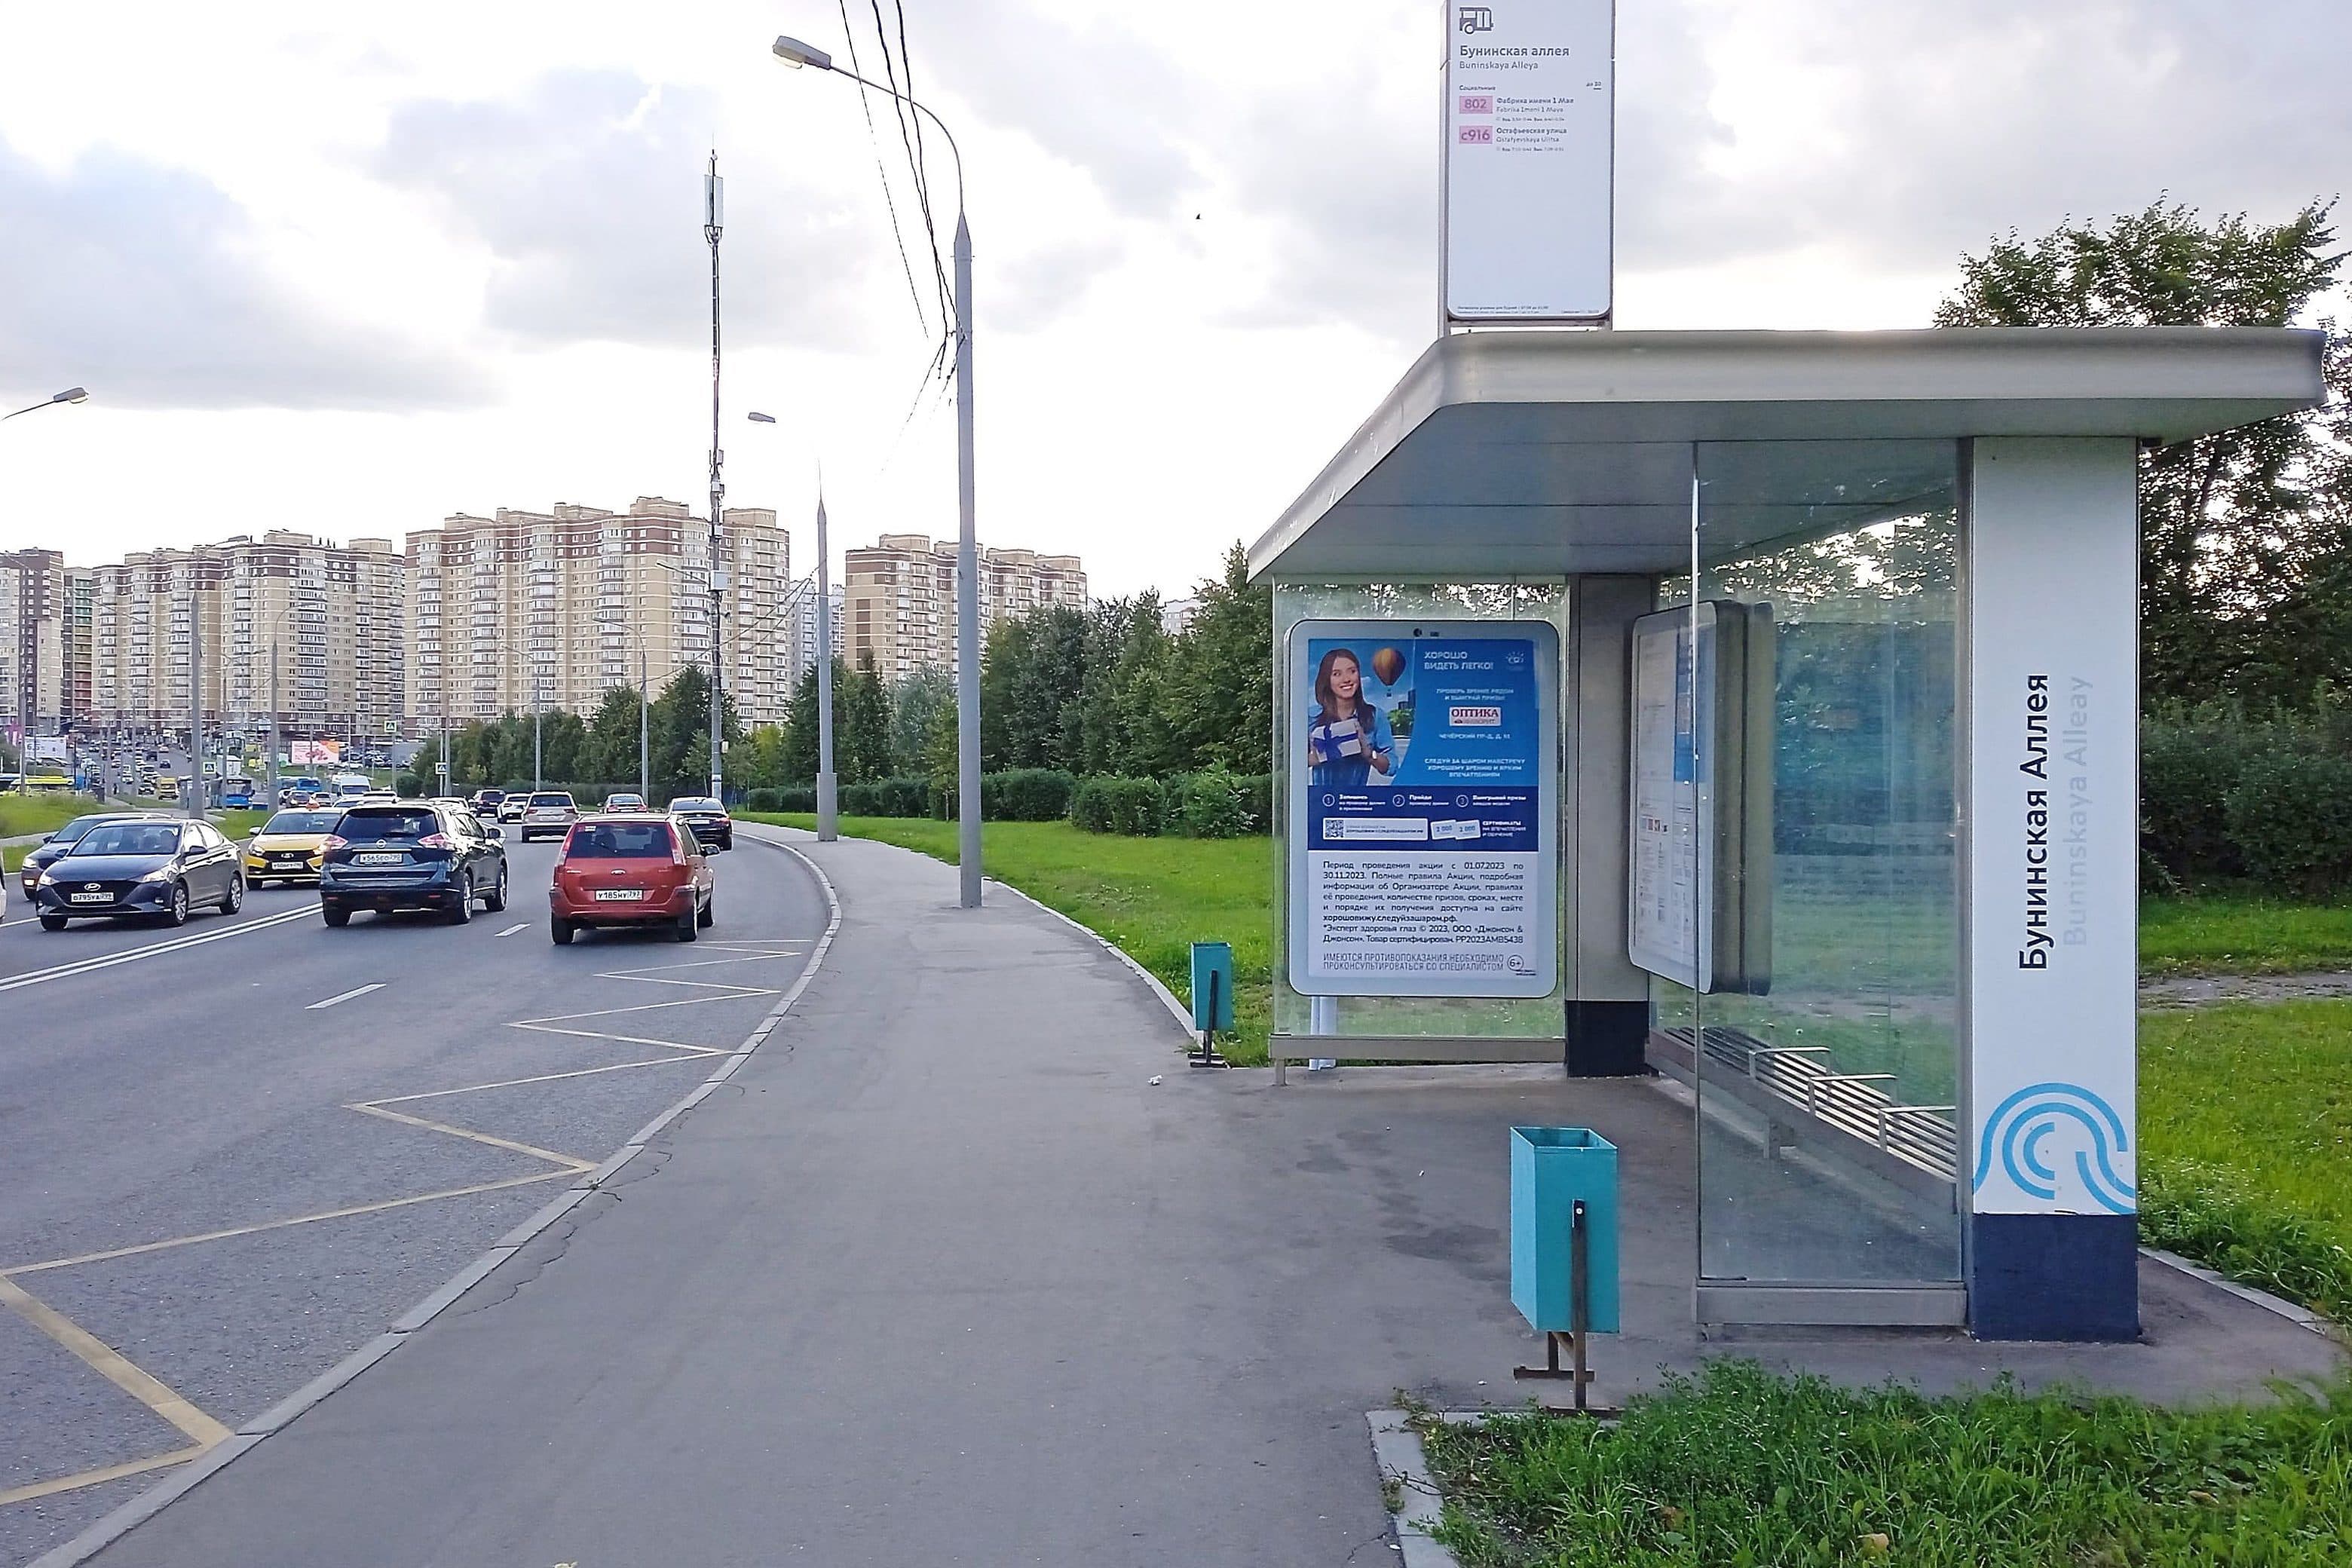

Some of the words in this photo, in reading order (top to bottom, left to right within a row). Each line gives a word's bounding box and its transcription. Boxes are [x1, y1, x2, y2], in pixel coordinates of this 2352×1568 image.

[1459, 45, 1528, 58] Бунинская
[1531, 47, 1570, 57] аллея
[1459, 61, 1509, 70] Buninskaya
[1511, 61, 1539, 70] Alleya
[1465, 99, 1487, 109] 802
[1461, 129, 1490, 141] с916
[1424, 651, 1468, 660] ХОРОШО
[1424, 662, 1459, 671] ВИДЕТЬ
[1461, 662, 1494, 670] ЛЕГКО!
[1451, 709, 1499, 718] ОПТИКА
[2063, 676, 2093, 766] Alleay
[2019, 674, 2049, 780] Аллея
[1323, 861, 1354, 869] Период
[2063, 776, 2093, 947] Buninskaya
[2019, 790, 2055, 970] Бунинская
[1323, 882, 1374, 890] информация
[1392, 882, 1449, 891] Организаторе
[1323, 953, 1362, 962] ИМЕЮТСЯ
[1364, 953, 1447, 962] ПРОТИВОПОКАЗАНИЯ
[1450, 954, 1504, 963] НЕОБХОДИМО
[1509, 958, 1521, 967] 6+
[1323, 962, 1423, 970] ПРОКОНСУЛЬТИРОВАТЬСЯ
[1426, 963, 1437, 971] СО
[1439, 963, 1504, 971] СПЕЦИАЛИСТОМ
